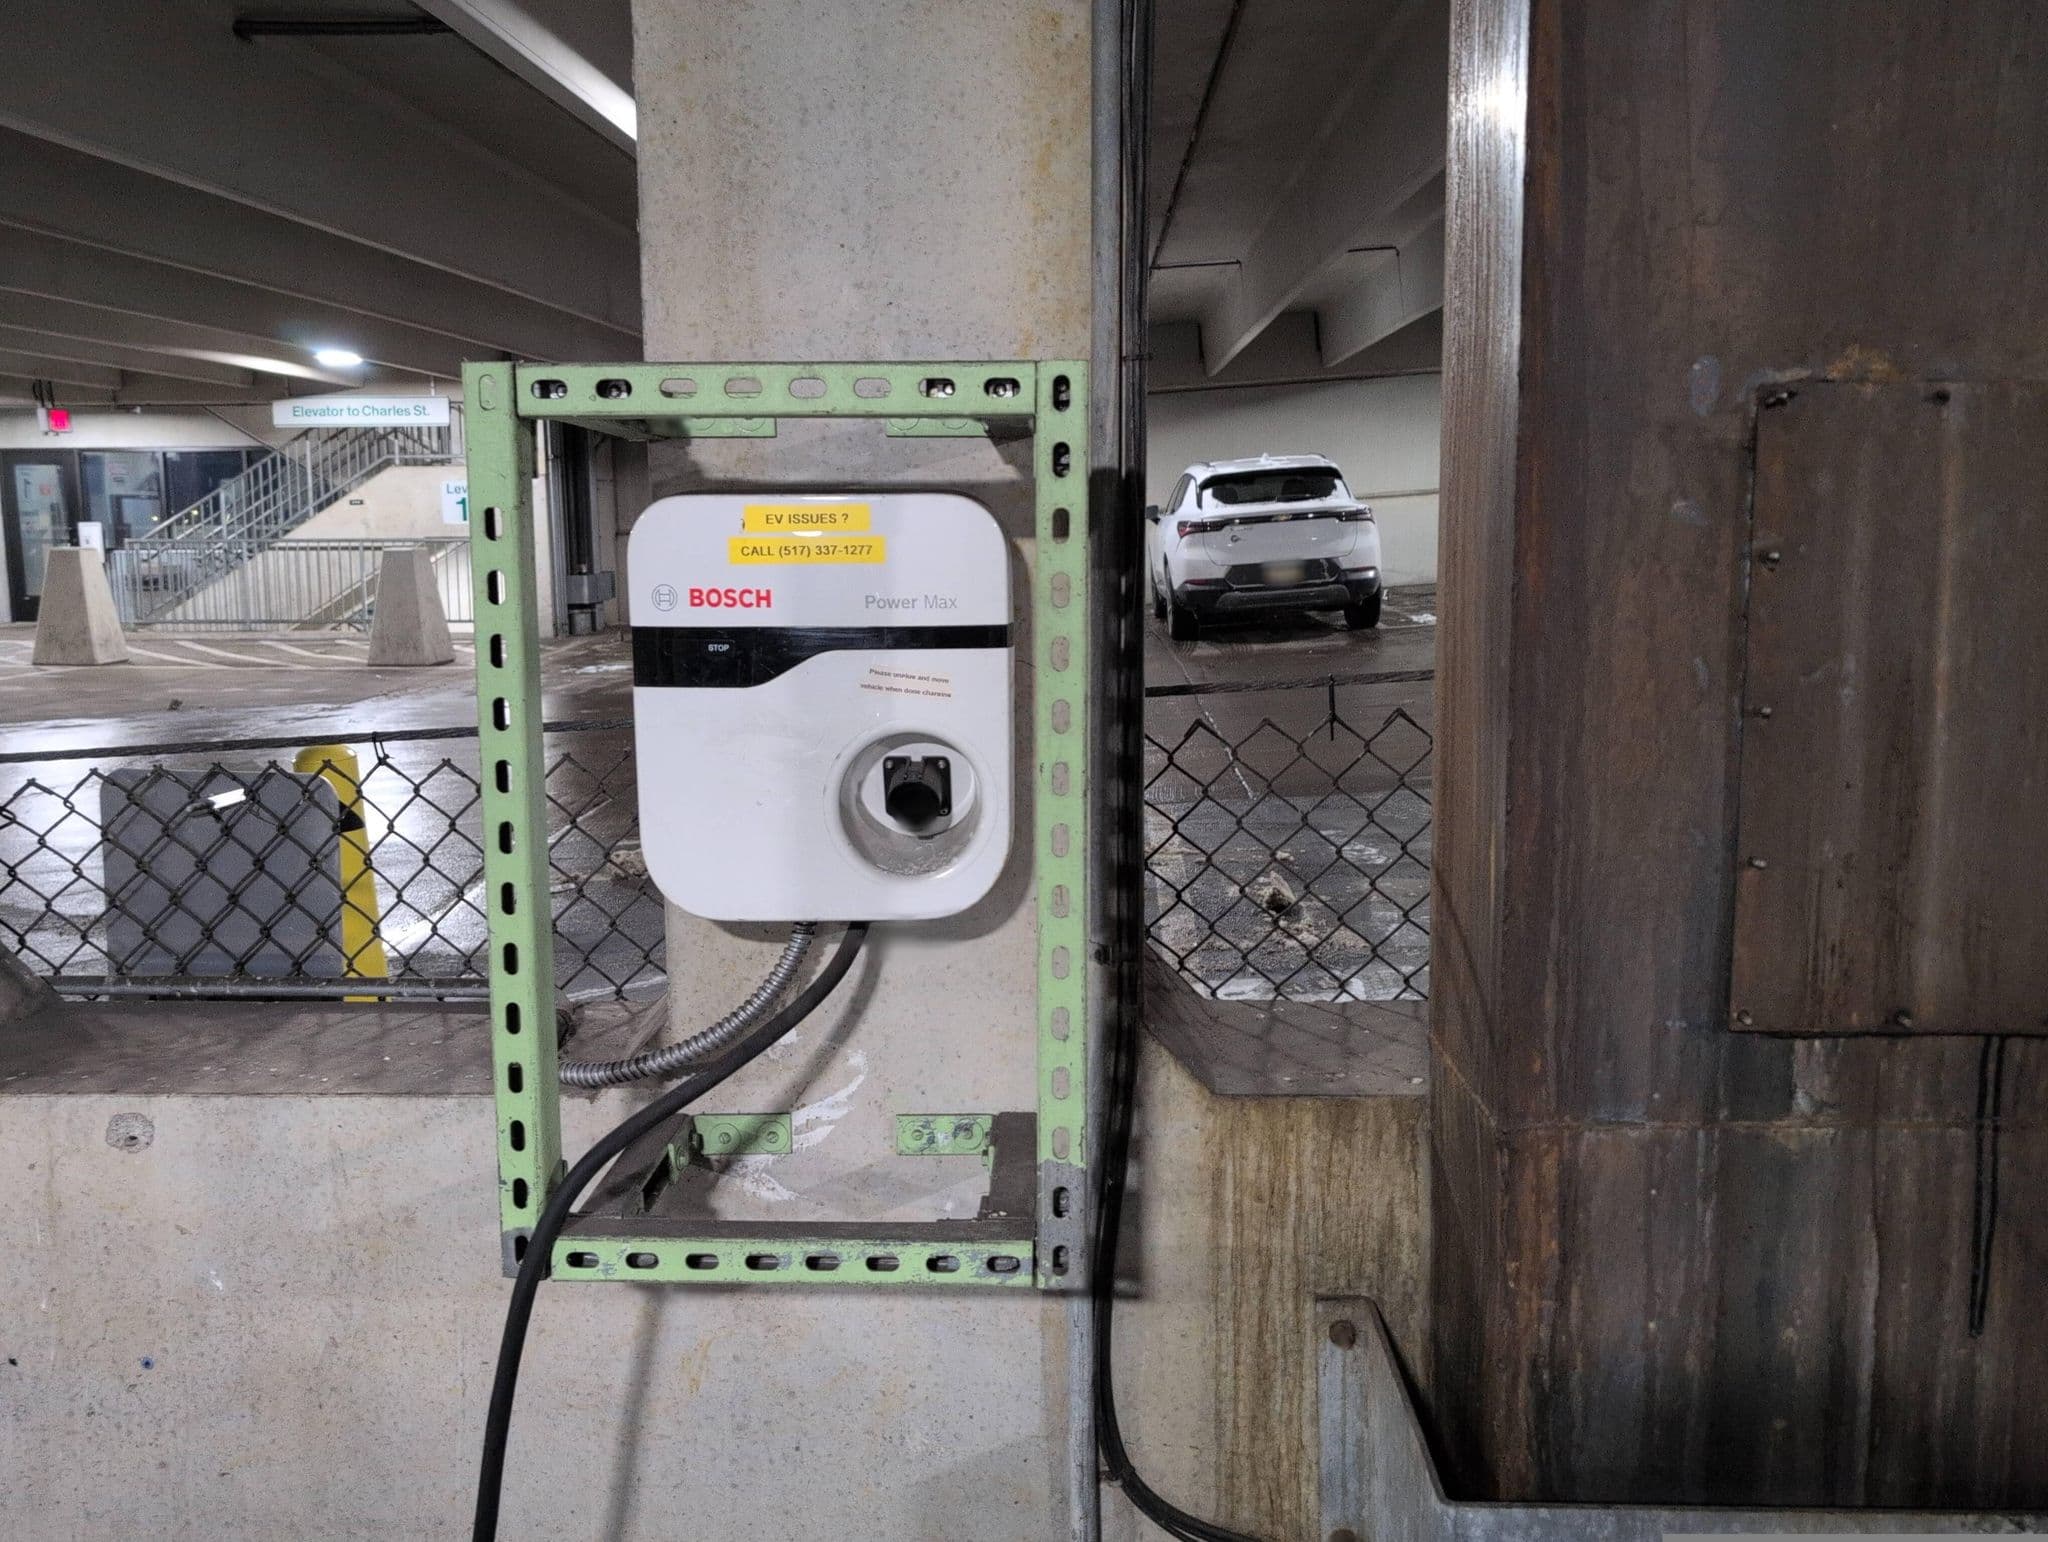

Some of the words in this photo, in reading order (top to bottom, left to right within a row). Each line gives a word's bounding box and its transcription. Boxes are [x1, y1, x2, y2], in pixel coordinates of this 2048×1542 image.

[292, 405, 344, 417] Elevator
[347, 406, 360, 417] to
[361, 405, 411, 416] Charles
[413, 405, 430, 416] St.
[456, 497, 468, 521] 1
[765, 513, 783, 525] EV
[788, 513, 837, 524] ISSUES
[841, 512, 849, 524] ?
[740, 545, 774, 557] CALL
[778, 545, 811, 558] (517)
[815, 544, 873, 556] 337-1277
[688, 588, 772, 608] BOSCH
[864, 594, 918, 609] Power
[924, 594, 958, 609] Max
[708, 643, 730, 652] STOP
